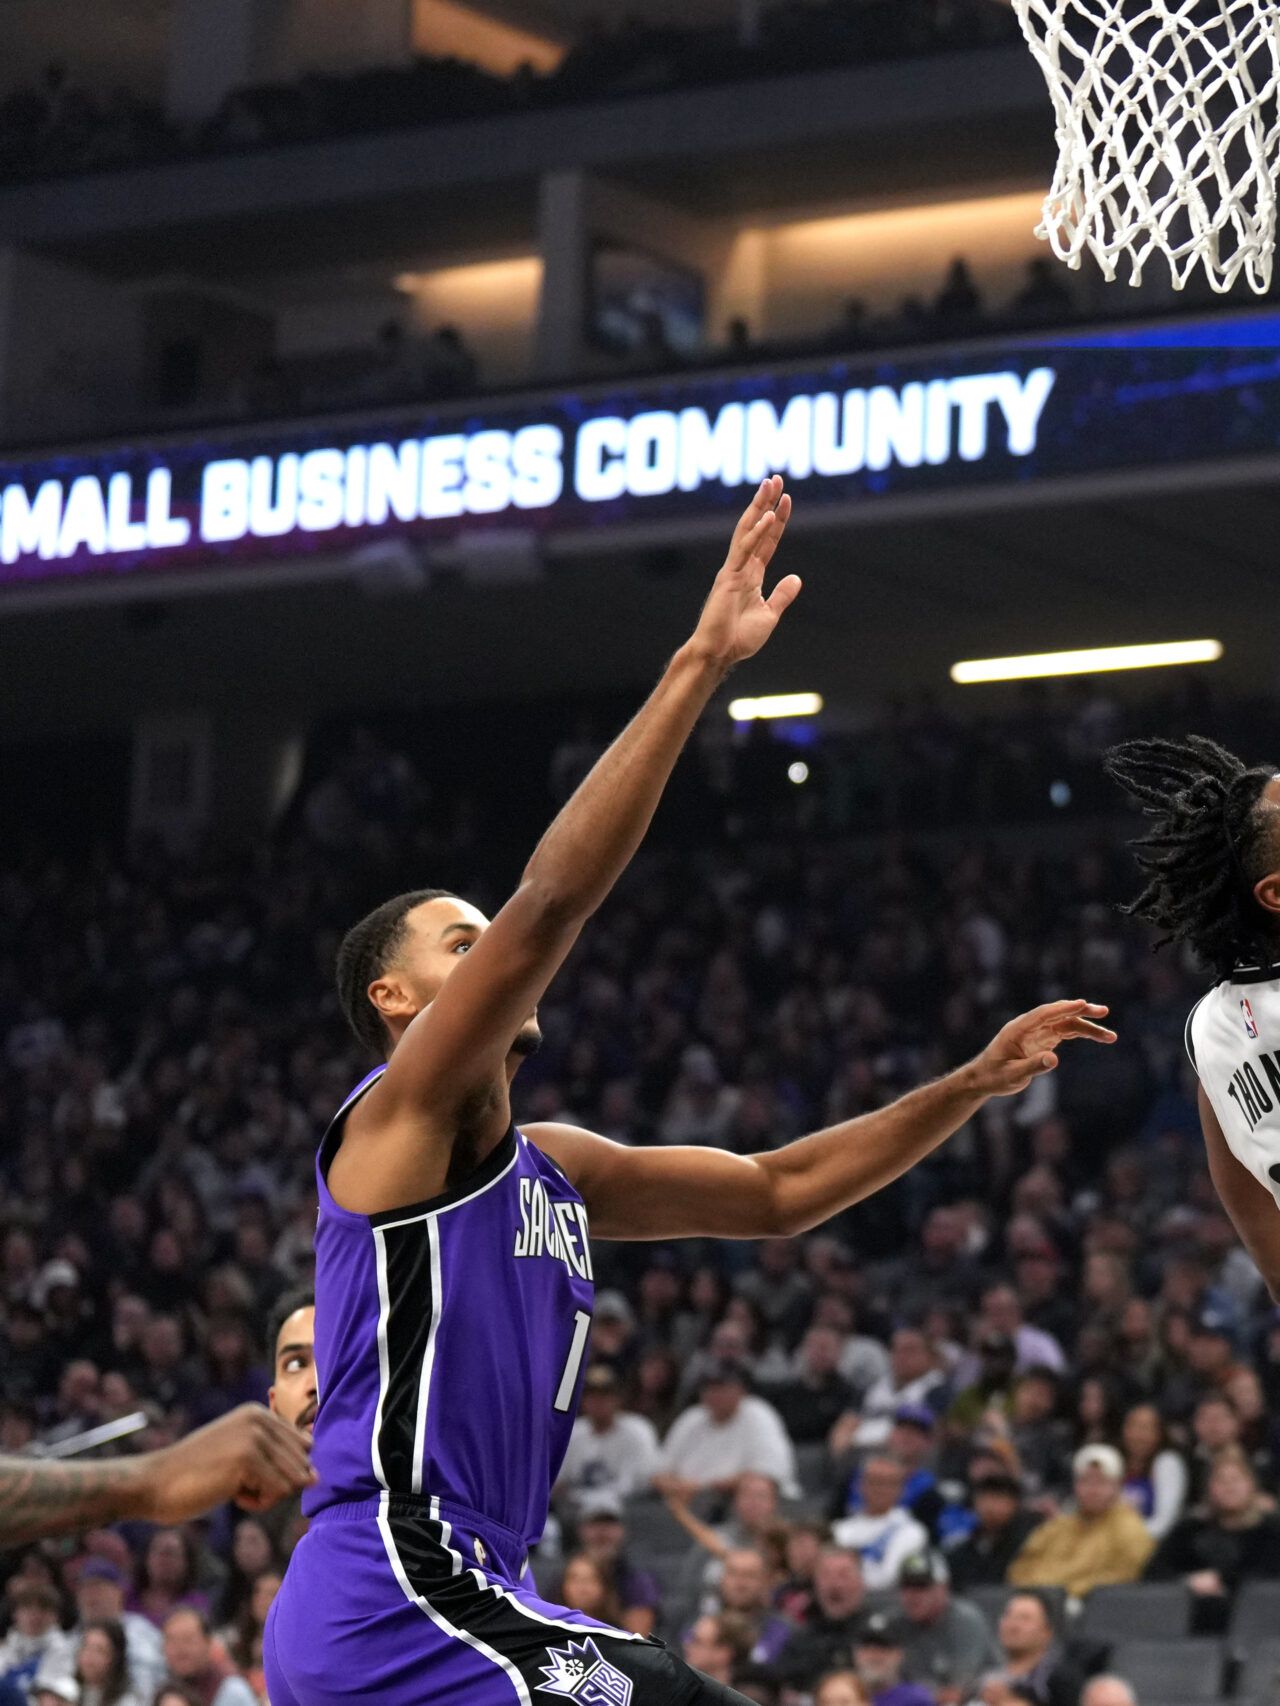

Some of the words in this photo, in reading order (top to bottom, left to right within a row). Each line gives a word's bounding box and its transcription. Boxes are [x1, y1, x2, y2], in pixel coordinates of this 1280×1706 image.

[2, 467, 191, 565] MALL
[200, 424, 563, 542] BUSINESS
[575, 367, 1056, 501] COMMUNITY
